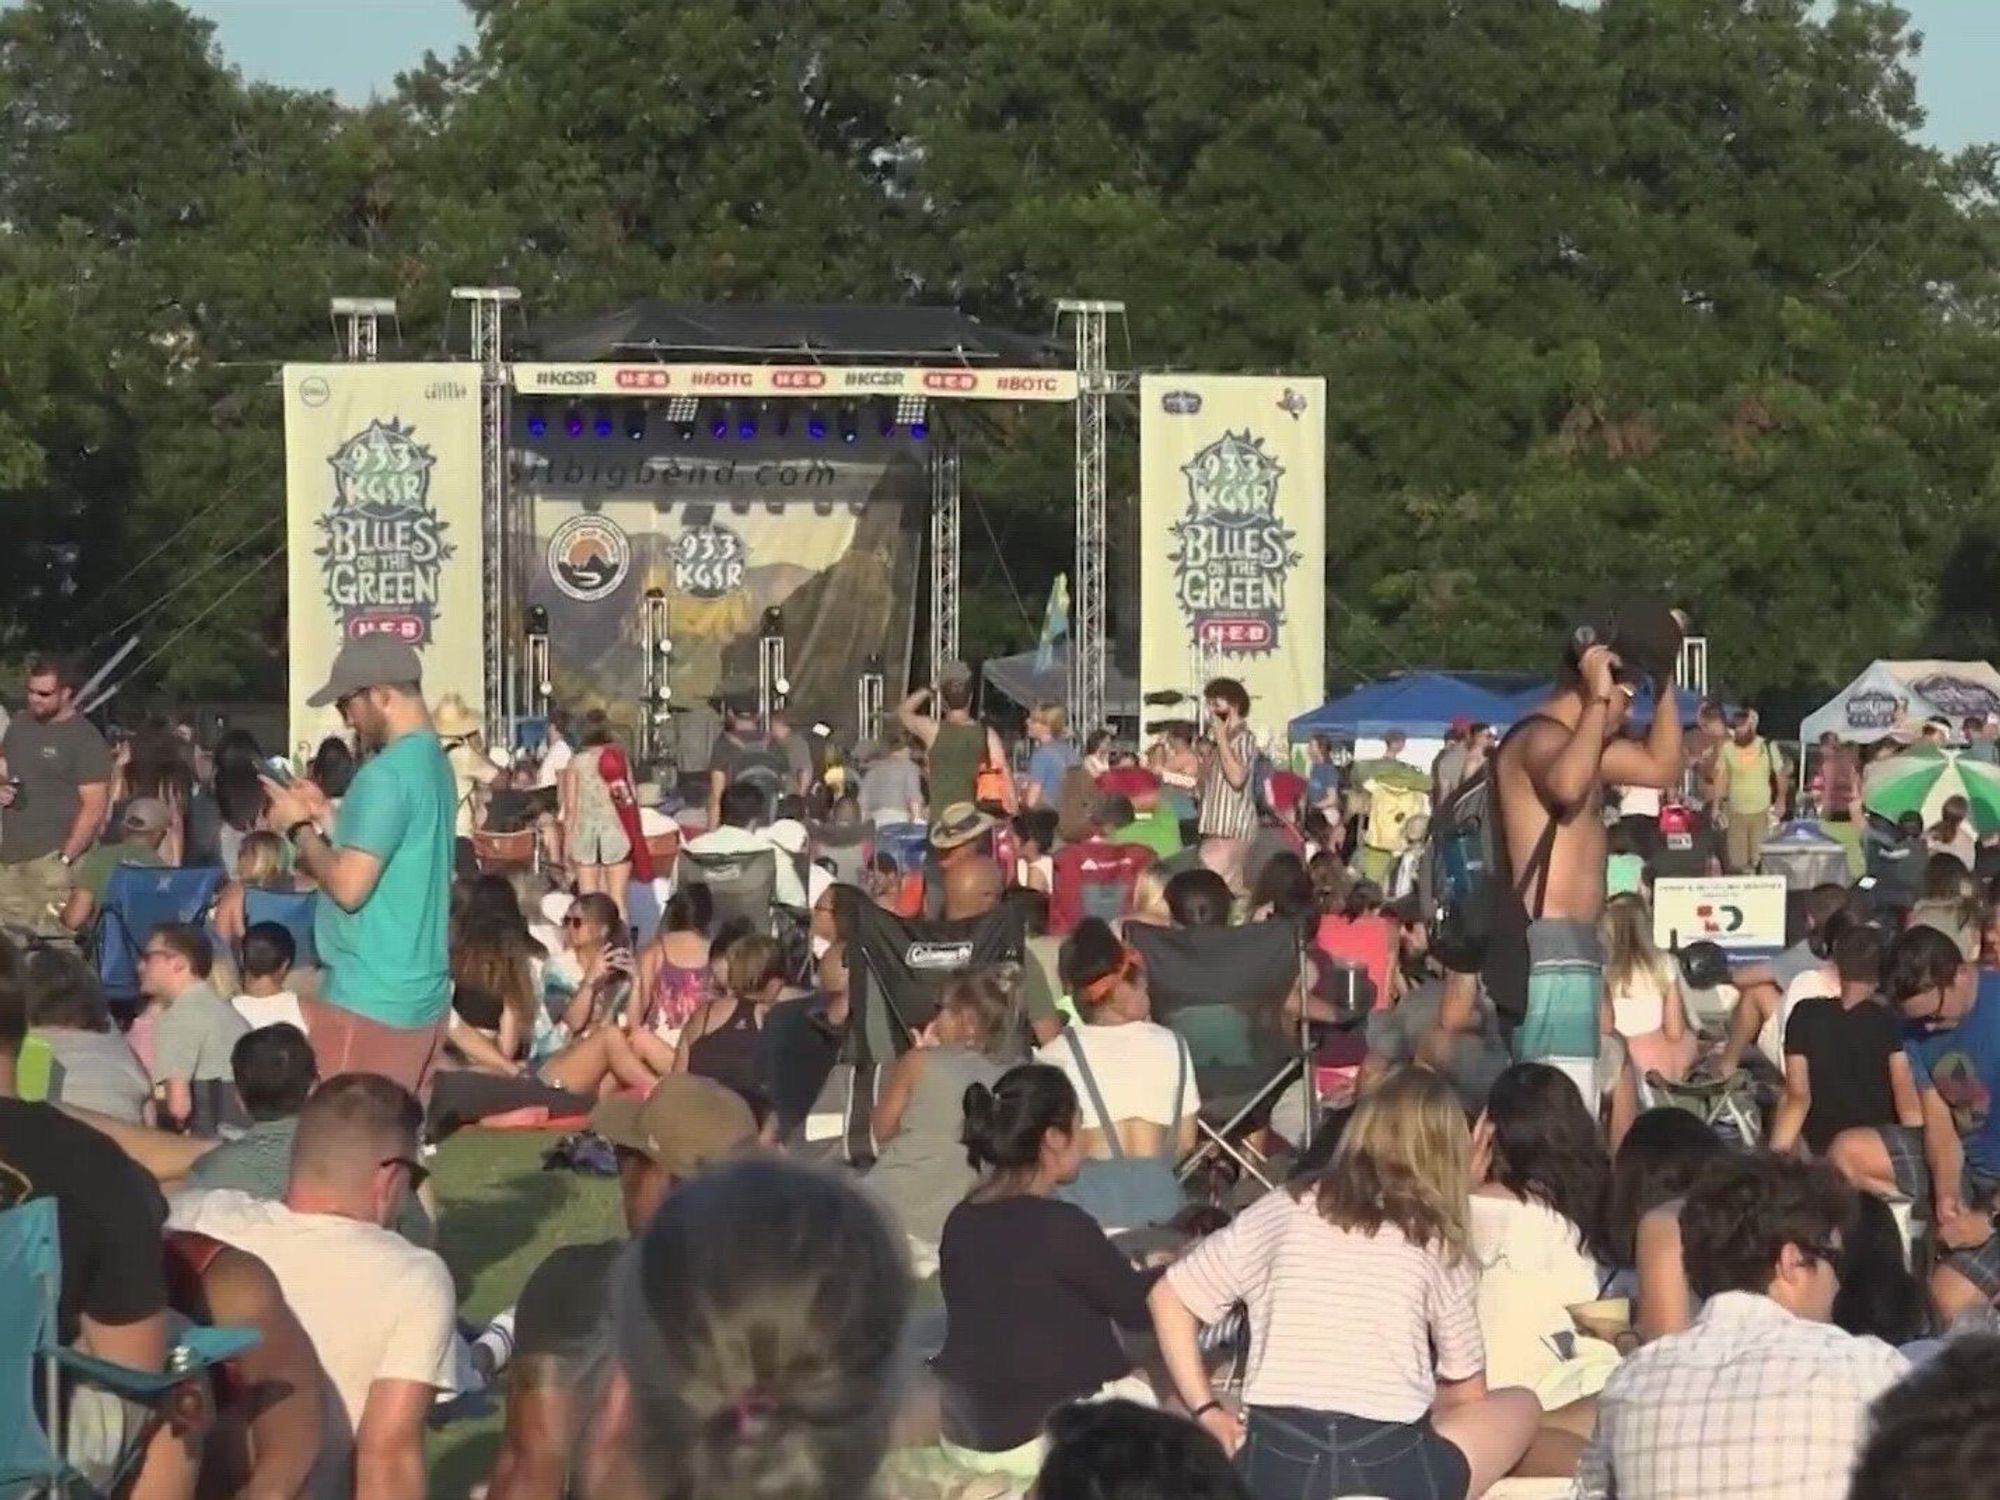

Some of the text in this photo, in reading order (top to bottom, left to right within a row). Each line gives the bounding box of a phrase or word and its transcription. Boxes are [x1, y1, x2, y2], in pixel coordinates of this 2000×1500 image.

[346, 475, 419, 505] KGSR
[1197, 483, 1269, 513] KGSR
[332, 516, 438, 562] BLUES
[1186, 524, 1284, 568] BLUES
[357, 554, 410, 571] ON THE
[675, 562, 743, 590] KGSR
[1207, 560, 1259, 577] ON THE
[331, 566, 436, 605] GREEN
[1182, 570, 1284, 611] GREEN
